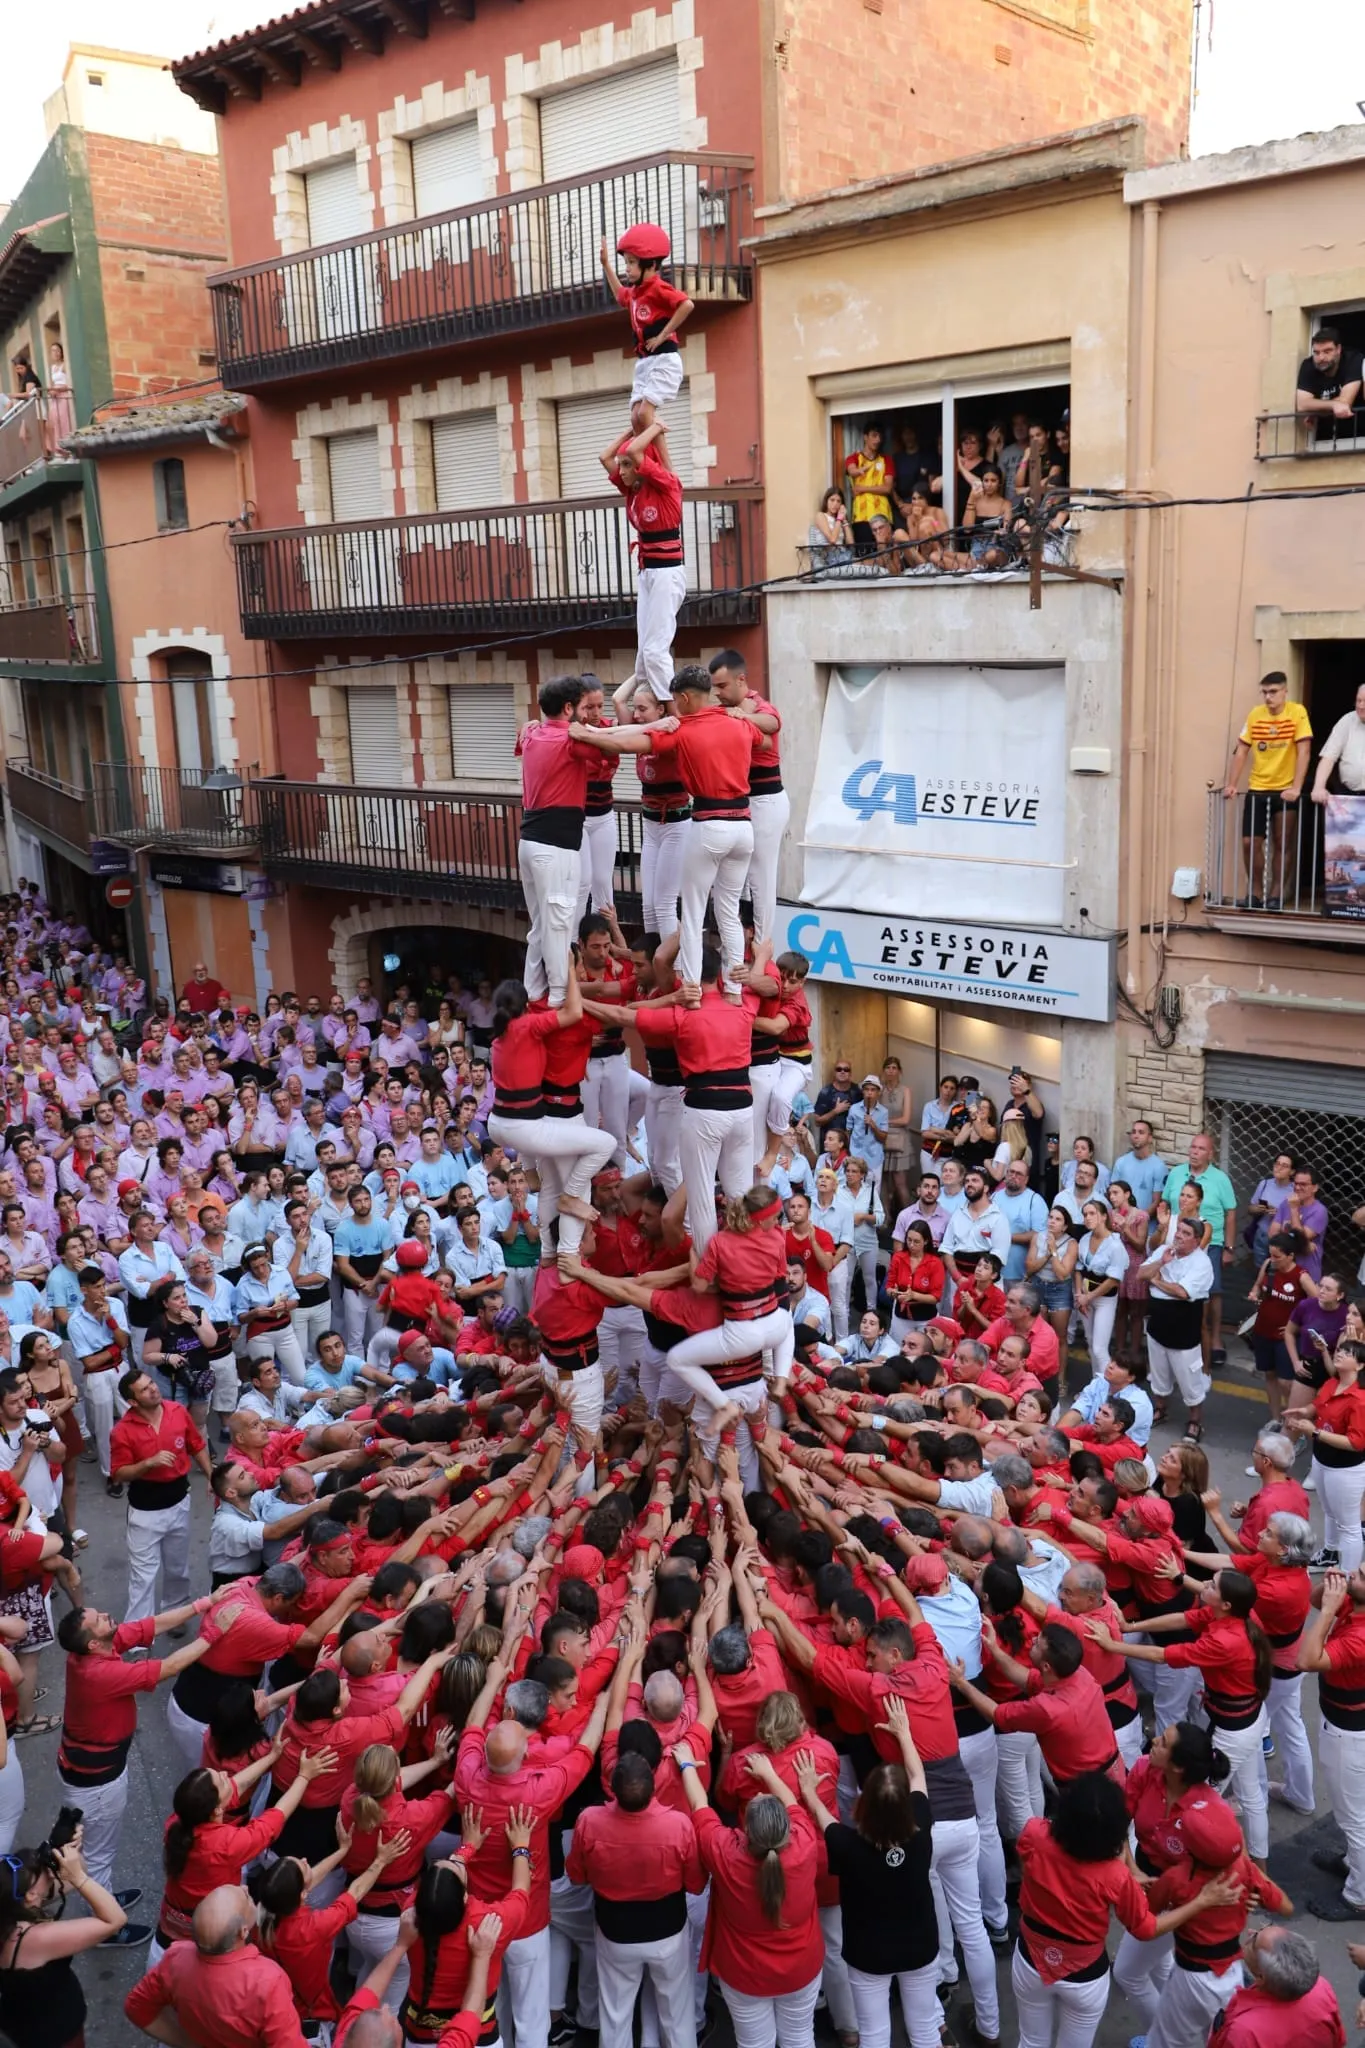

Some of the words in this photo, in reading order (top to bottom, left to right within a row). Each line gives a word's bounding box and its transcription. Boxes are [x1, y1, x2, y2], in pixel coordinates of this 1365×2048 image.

[841, 759, 918, 826] CA
[926, 778, 1041, 795] ASSESSORIA
[921, 793, 1039, 820] ESTEVE
[787, 914, 856, 979] CA
[881, 927, 1049, 960] ASSESSORIA
[880, 946, 1049, 984] ESTEVE
[873, 973, 954, 992] COMPTABILITAT
[965, 986, 1058, 1006] ASSESSORAMENT
